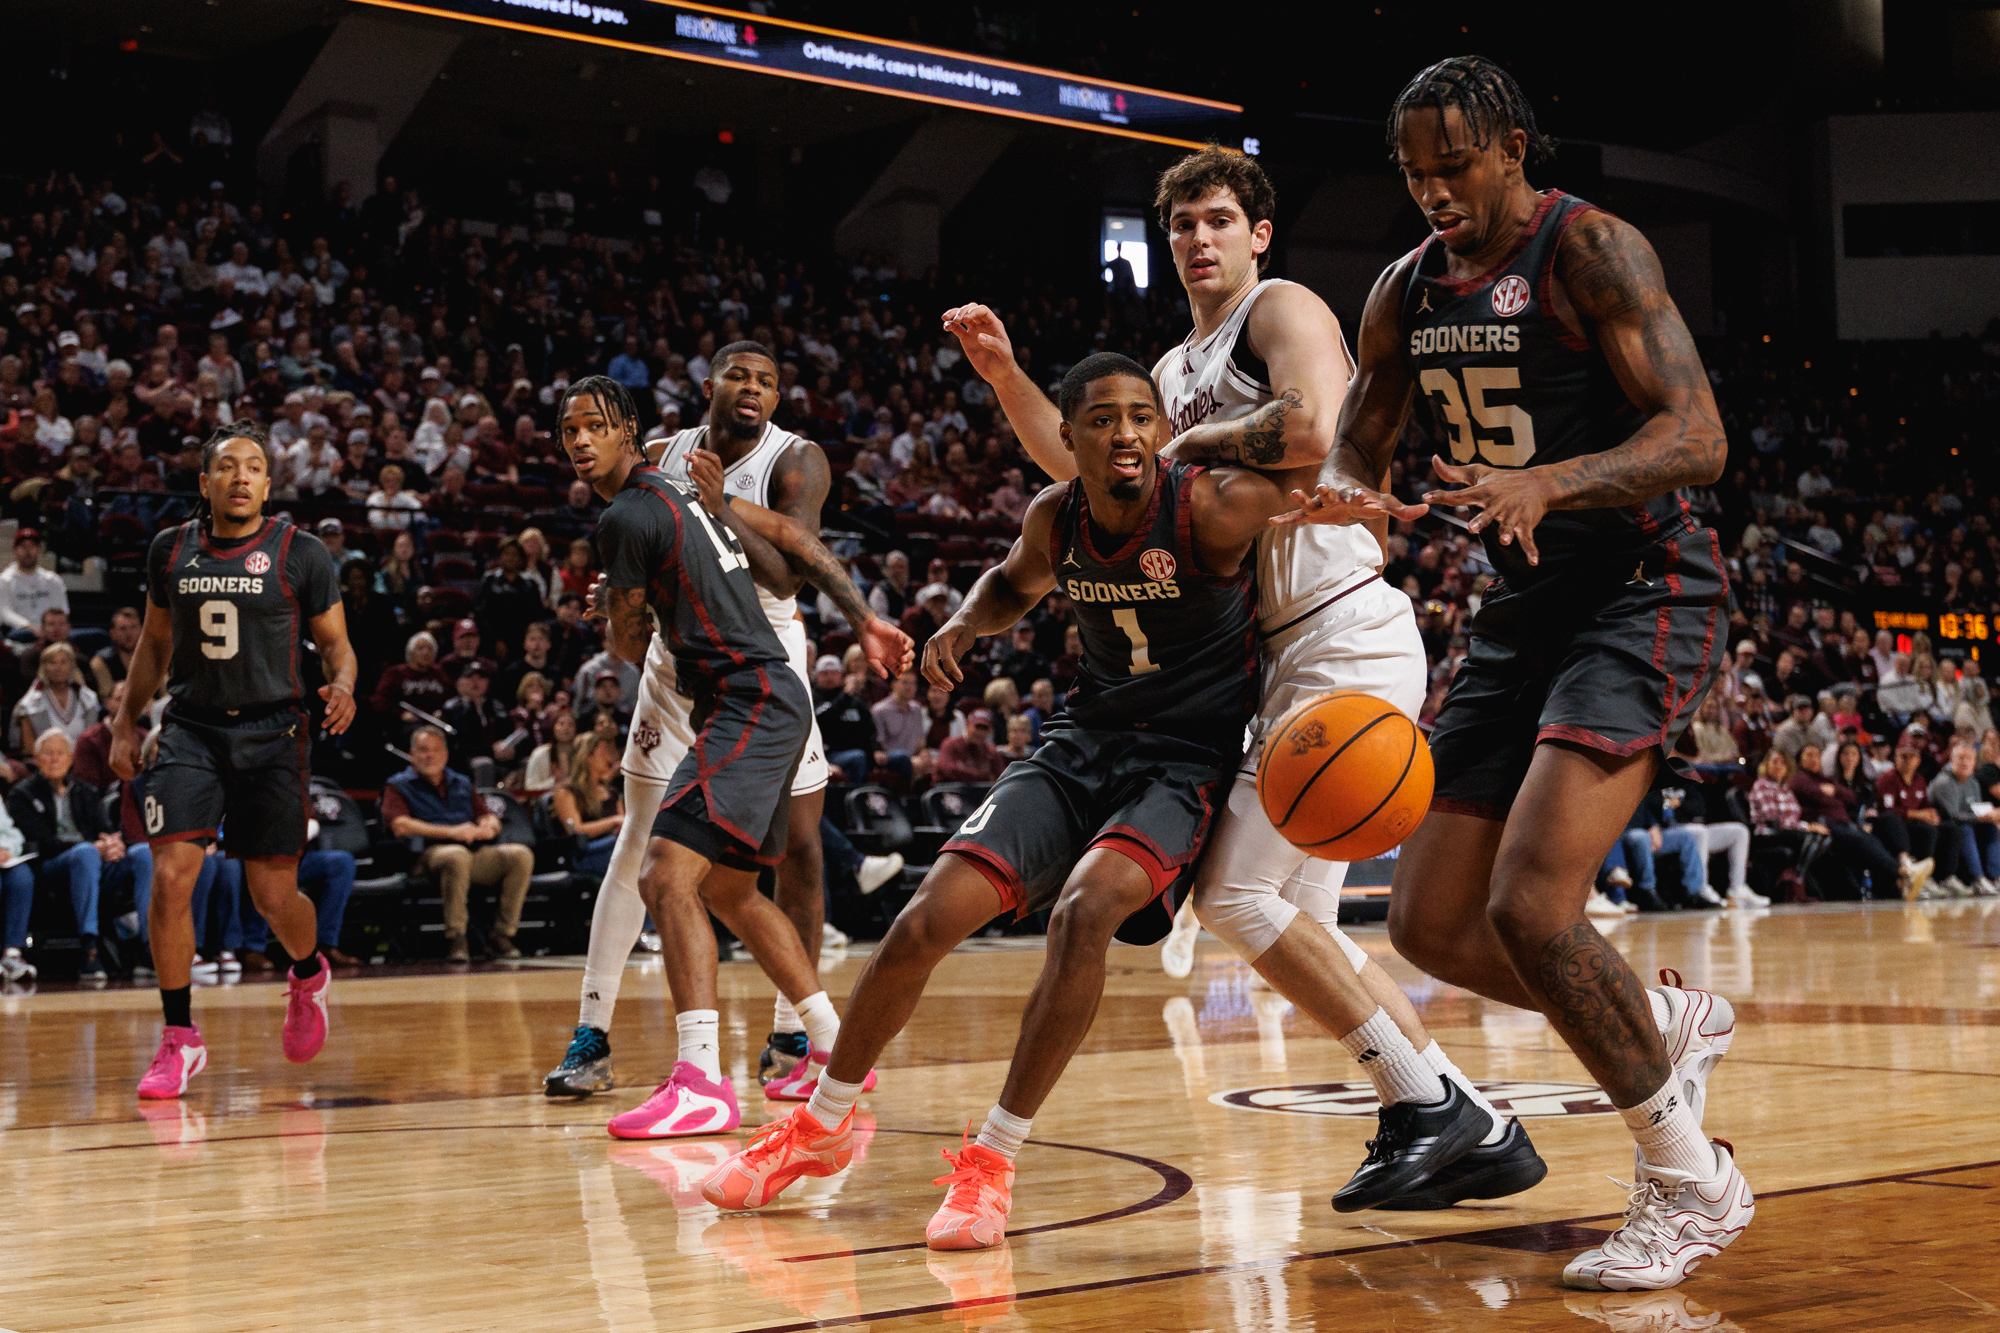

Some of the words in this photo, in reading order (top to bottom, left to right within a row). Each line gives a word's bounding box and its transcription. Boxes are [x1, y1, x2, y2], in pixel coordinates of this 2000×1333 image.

[591, 6, 629, 25] you.
[802, 41, 886, 72] Orthopedic
[885, 60, 917, 77] care
[917, 62, 974, 88] tailored
[974, 73, 990, 91] to
[991, 79, 1021, 96] you.
[1493, 278, 1529, 314] SEC
[1411, 325, 1520, 355] SOONERS
[1419, 367, 1536, 467] 35
[1140, 550, 1174, 580] SEC
[178, 577, 264, 595] SOONERS
[1067, 578, 1181, 603] SOONERS
[199, 600, 239, 660] 9
[1111, 607, 1162, 676] 1
